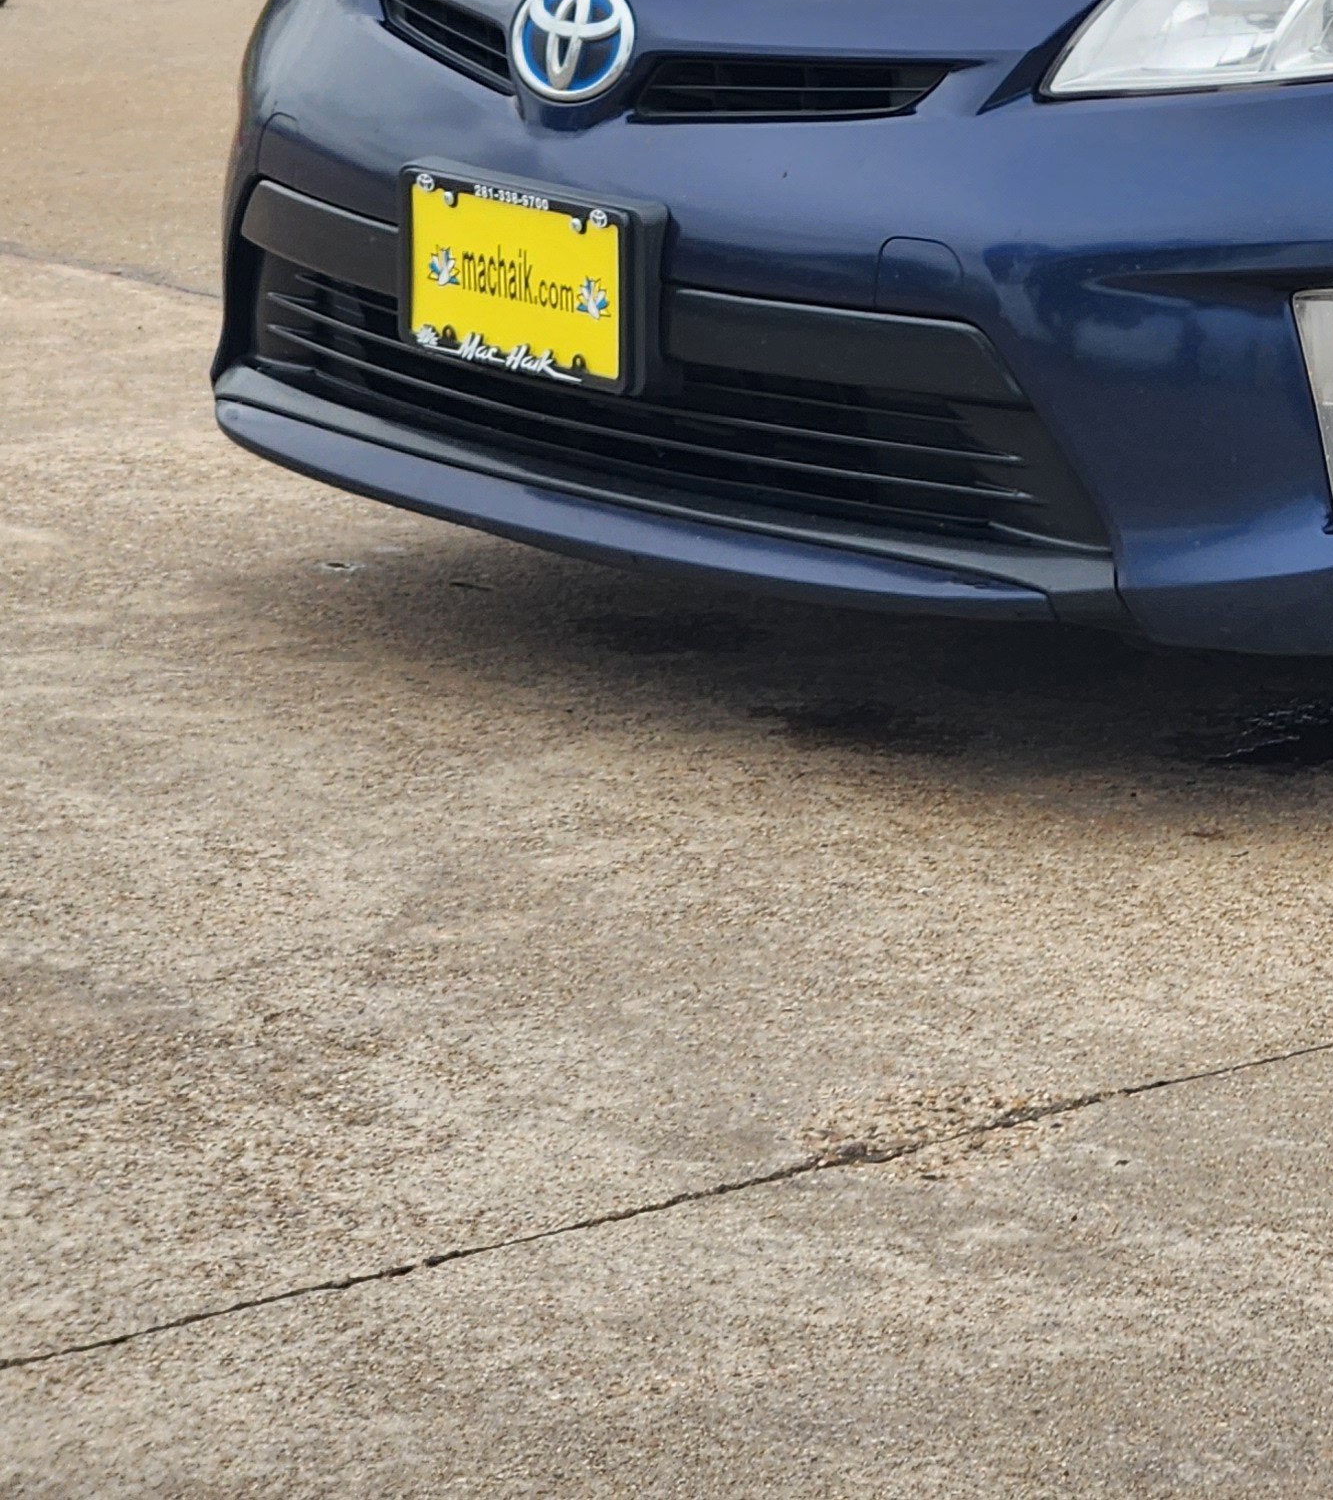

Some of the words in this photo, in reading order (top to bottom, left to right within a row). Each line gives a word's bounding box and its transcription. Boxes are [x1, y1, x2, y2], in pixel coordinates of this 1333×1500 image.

[461, 244, 575, 313] machaik.com
[457, 332, 505, 362] Mac
[505, 343, 572, 379] Haik
